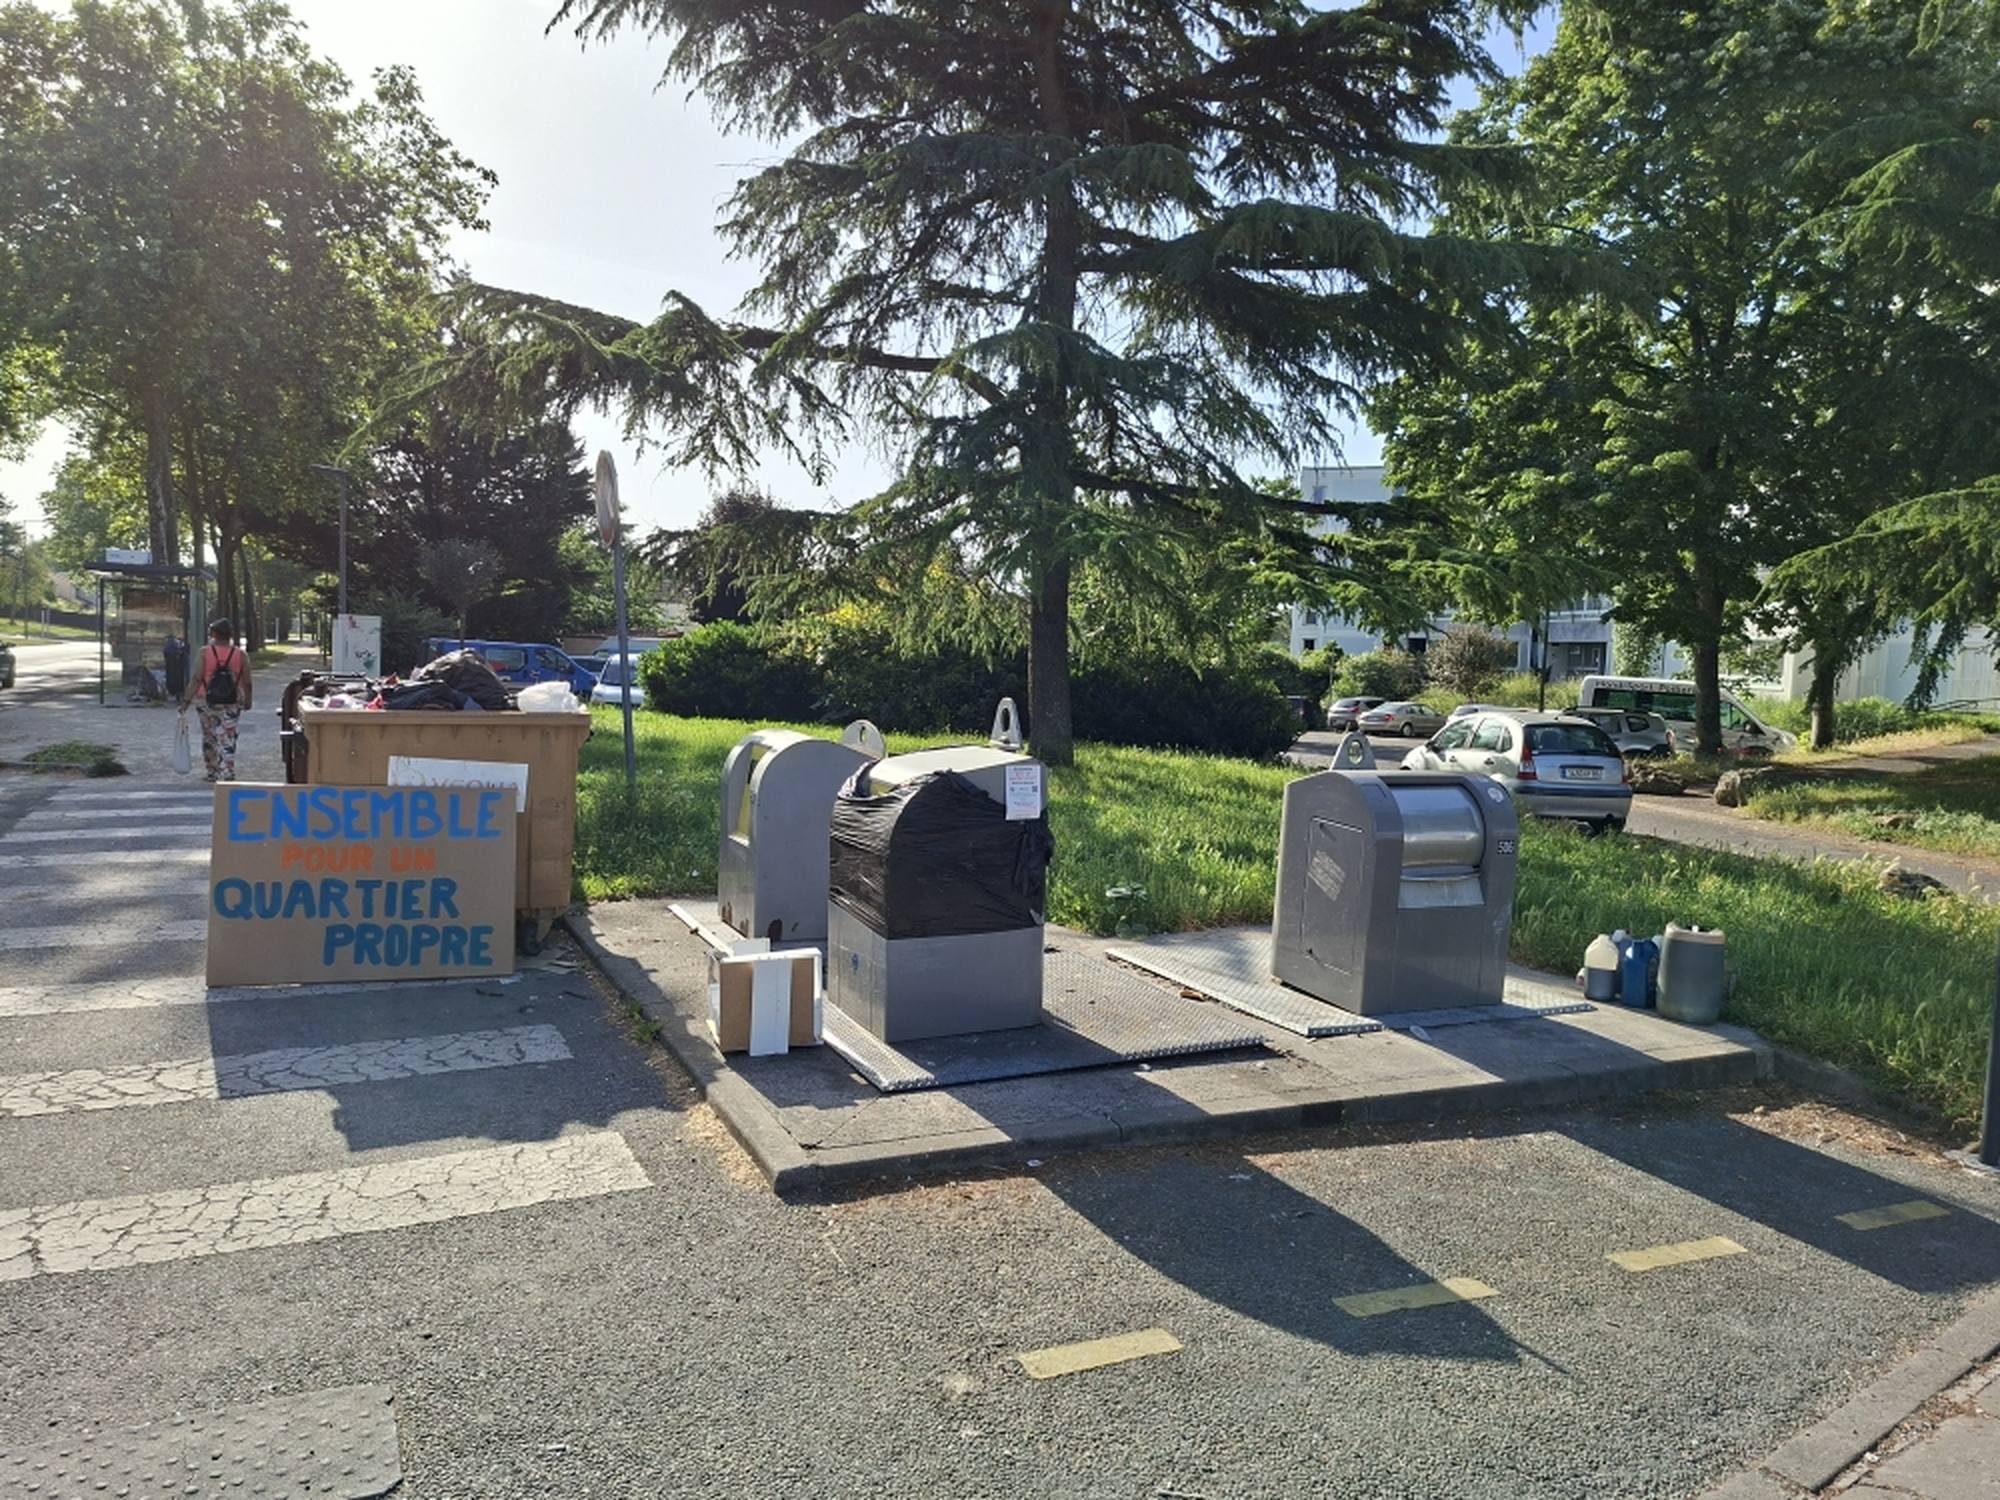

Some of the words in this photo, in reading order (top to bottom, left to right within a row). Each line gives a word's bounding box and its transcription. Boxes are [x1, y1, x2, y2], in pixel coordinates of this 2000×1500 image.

[227, 787, 504, 842] ENSEMBLE
[282, 845, 373, 874] POUR
[389, 847, 437, 873] UN
[213, 877, 460, 921] QUARTIER
[322, 923, 495, 967] PROPRE
